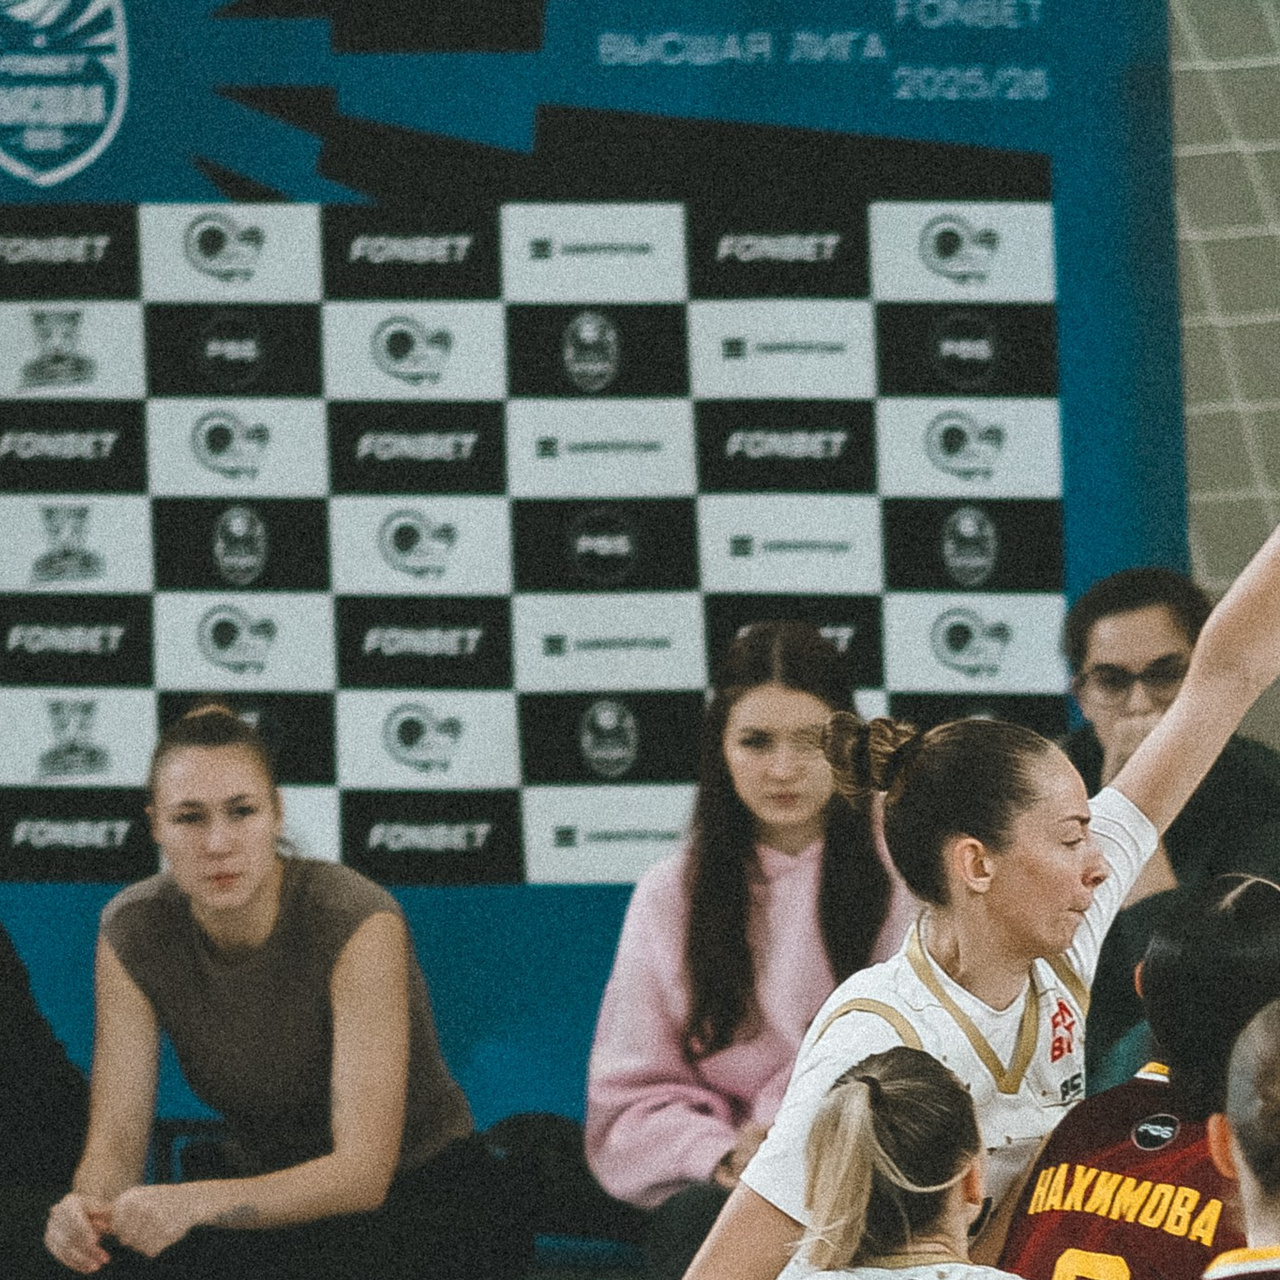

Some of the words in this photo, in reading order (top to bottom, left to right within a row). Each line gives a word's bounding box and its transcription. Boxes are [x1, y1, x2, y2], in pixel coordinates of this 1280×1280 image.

[893, 0, 1043, 29] FONBET
[597, 30, 772, 66] ВЫСШАЯ
[788, 30, 888, 63] ЛИГА
[892, 65, 1050, 101] 2025/26
[350, 234, 472, 264] FONBET
[716, 233, 841, 262] FONBET
[357, 432, 479, 461] FONBET
[725, 430, 848, 459] FONBET
[7, 625, 125, 653] FONBET
[363, 627, 483, 656] FONBET
[12, 820, 131, 848] FONBET
[368, 822, 491, 851] FONBET
[1028, 1163, 1224, 1248] НАХИМОВА
